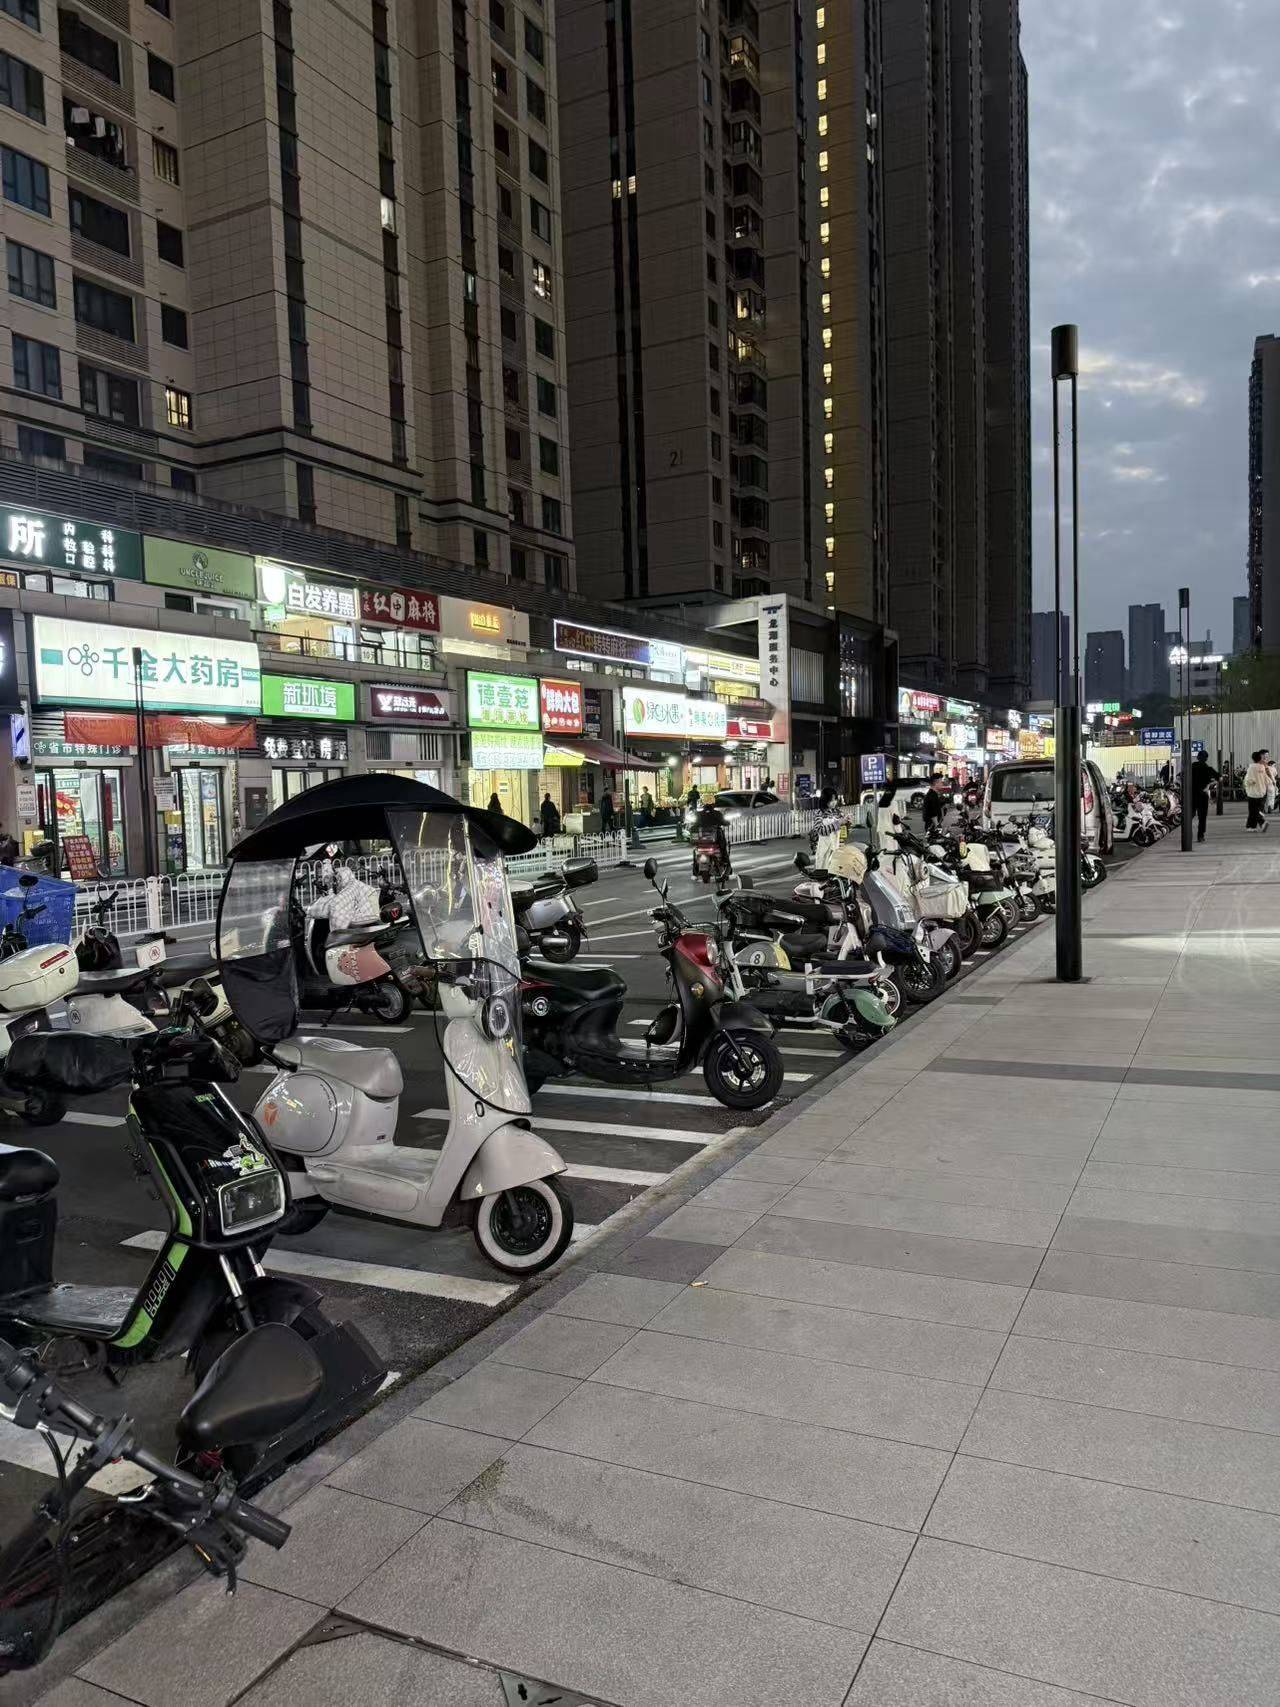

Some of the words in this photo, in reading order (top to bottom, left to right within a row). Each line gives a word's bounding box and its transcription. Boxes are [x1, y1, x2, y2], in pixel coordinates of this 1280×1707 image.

[8, 515, 45, 558] 所
[373, 591, 436, 625] 红中麻将
[102, 646, 240, 689] 千金大药房
[283, 682, 337, 708] 新环境
[263, 736, 347, 760] 免费登记房源
[868, 757, 878, 770] P
[753, 953, 761, 965] 8
